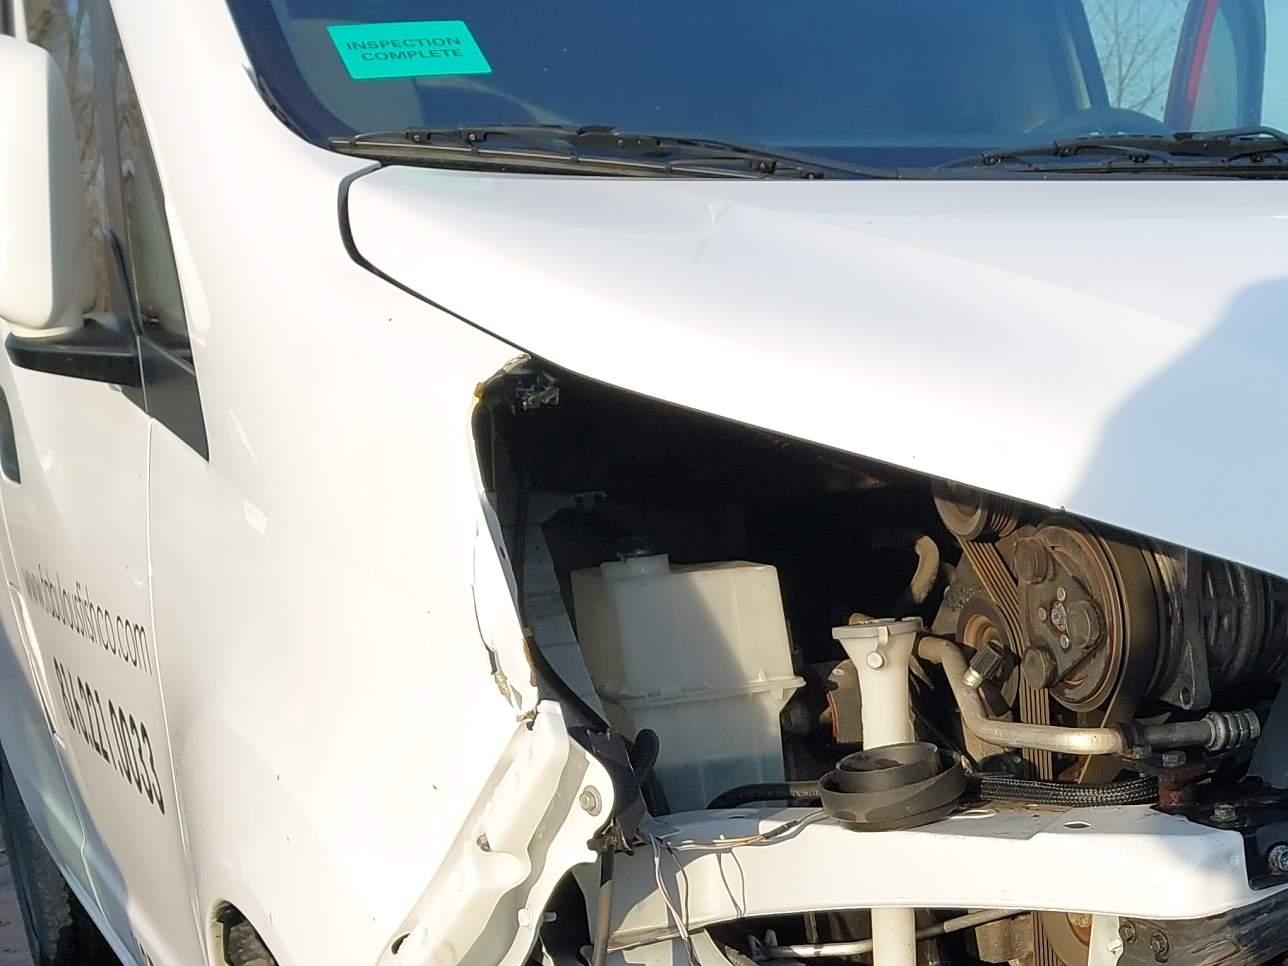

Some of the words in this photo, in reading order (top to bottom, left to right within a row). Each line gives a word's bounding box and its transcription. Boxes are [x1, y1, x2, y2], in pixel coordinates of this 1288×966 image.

[346, 37, 462, 51] INSPECTION
[361, 48, 465, 62] COMPLETE
[53, 656, 165, 815] 816.221.0033
